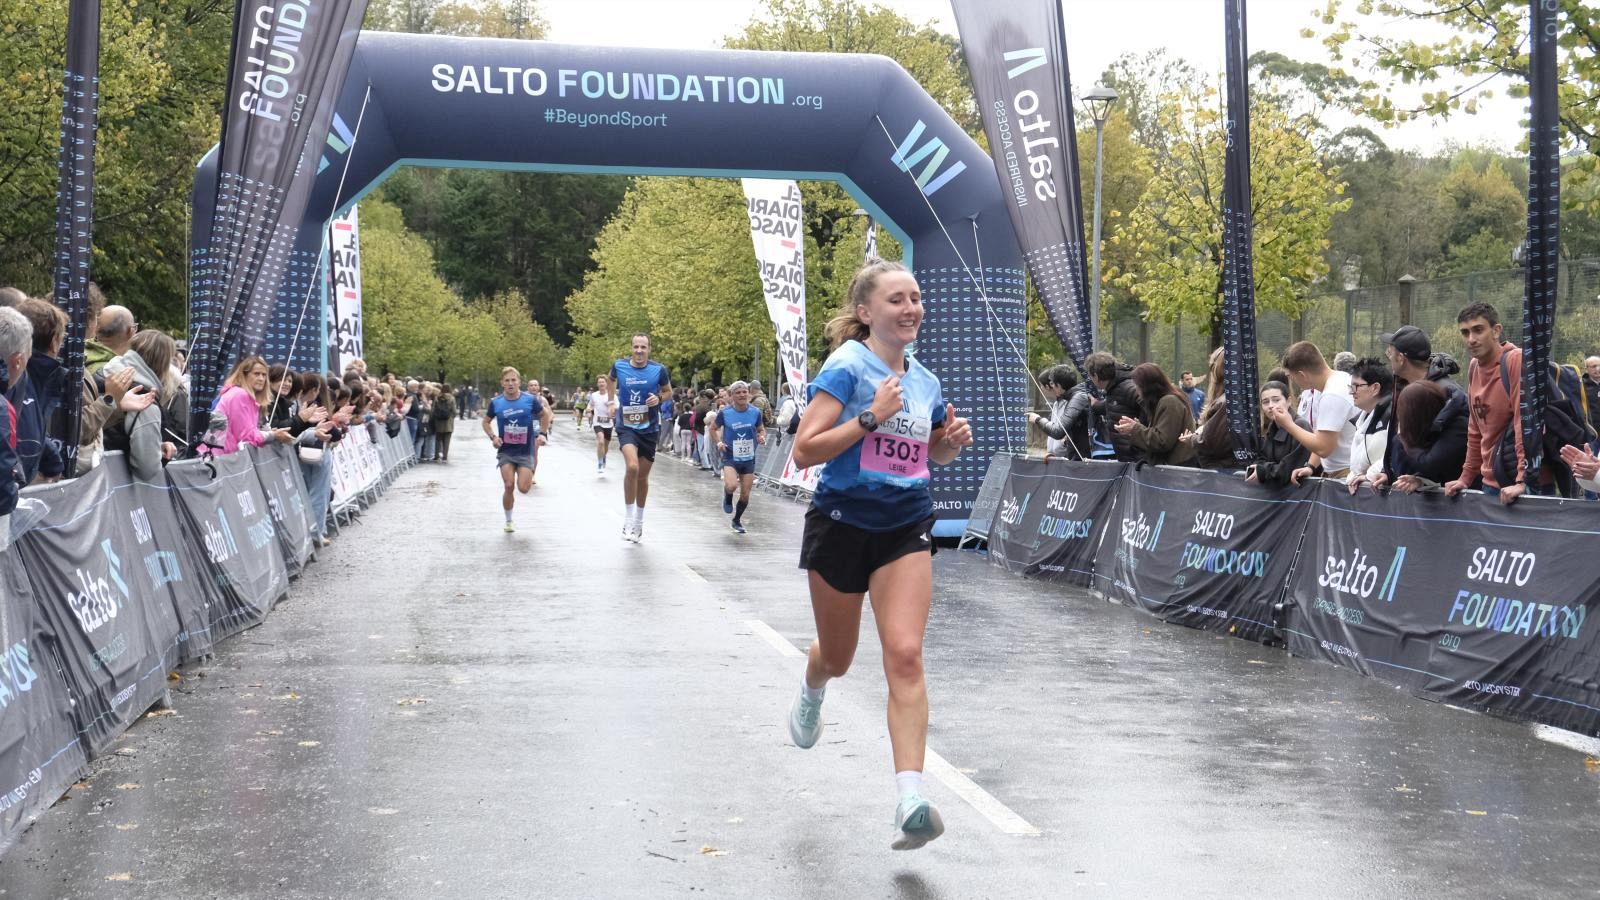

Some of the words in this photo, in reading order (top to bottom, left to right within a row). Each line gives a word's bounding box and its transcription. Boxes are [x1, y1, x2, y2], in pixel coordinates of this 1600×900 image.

[432, 64, 547, 96] SALTO
[558, 69, 784, 104] FOUNDATION
[791, 95, 822, 110] .org
[544, 108, 667, 128] #BeyondSport
[874, 437, 920, 463] 1303
[933, 500, 962, 510] SALTO
[1047, 489, 1079, 513] SALTO
[1191, 509, 1234, 540] SALTO
[1318, 547, 1378, 598] salto
[1467, 546, 1536, 587] SALTO
[67, 568, 117, 633] salto
